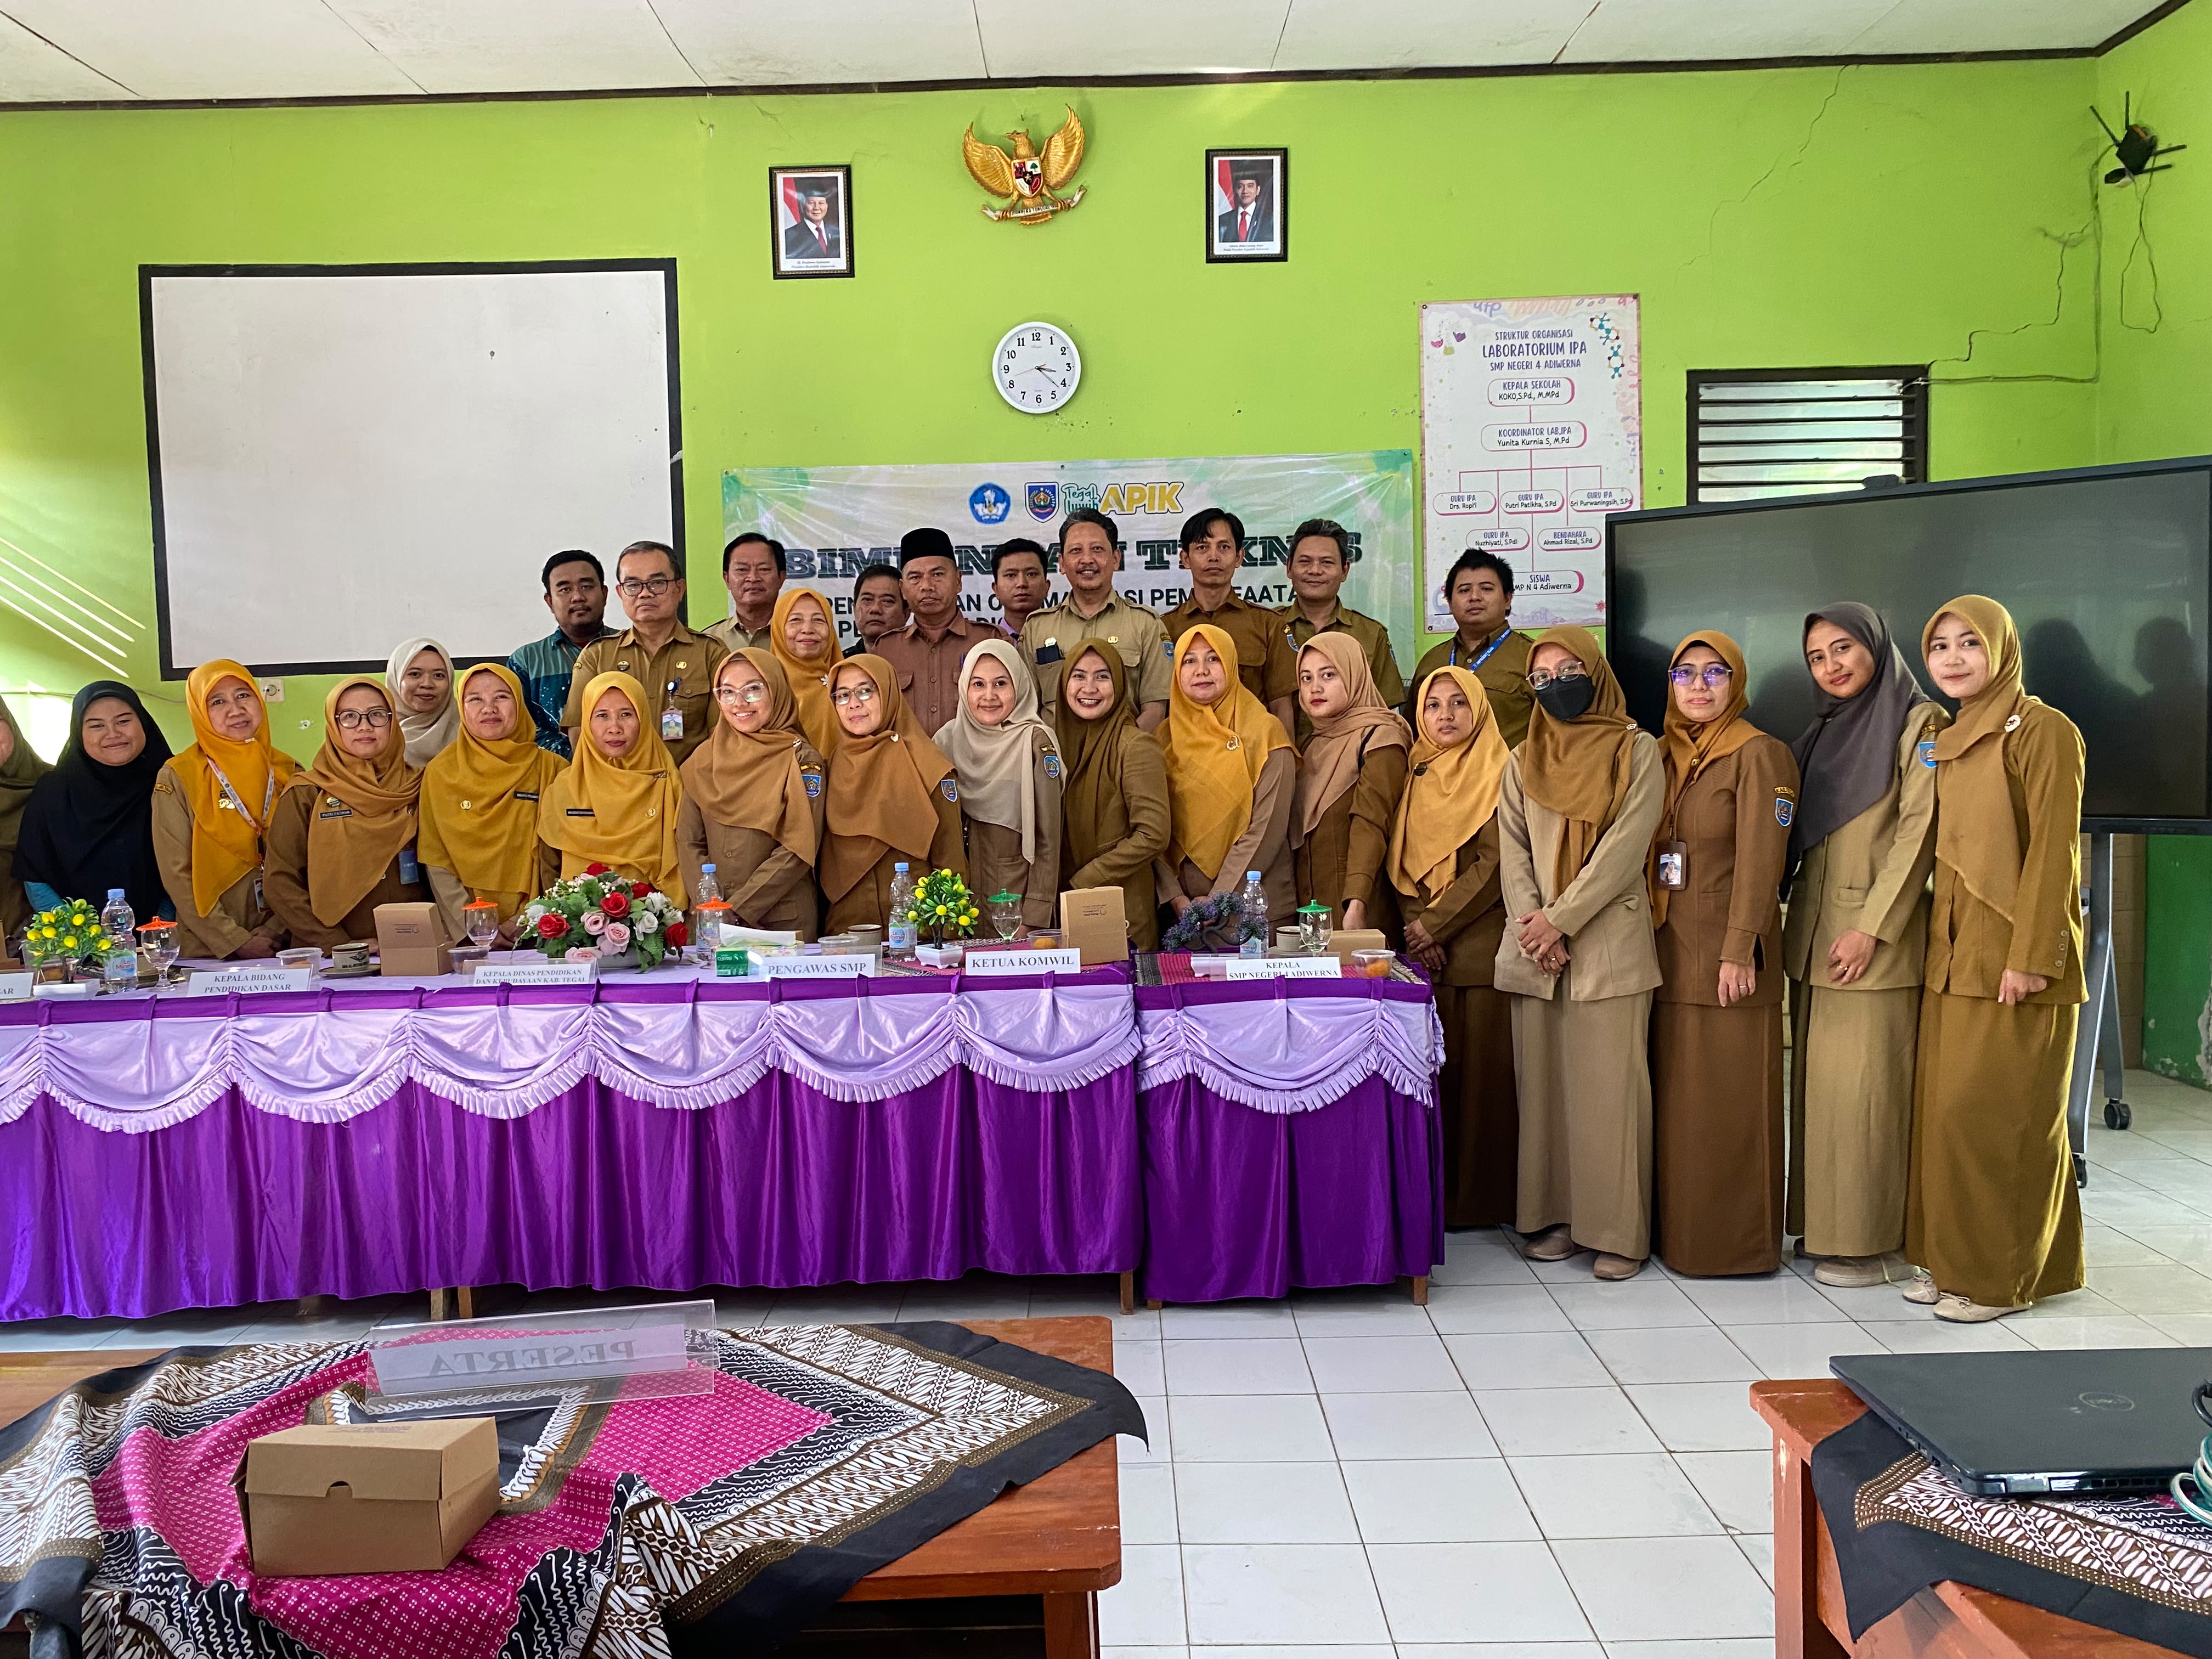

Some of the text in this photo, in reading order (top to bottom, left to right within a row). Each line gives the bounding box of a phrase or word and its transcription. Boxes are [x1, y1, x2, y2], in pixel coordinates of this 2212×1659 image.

[1031, 332, 1041, 341] 12
[1495, 330, 1529, 340] STRUKTUR
[1017, 337, 1025, 346] 11
[1049, 336, 1054, 345] 1
[1060, 347, 1066, 356] 2
[1482, 341, 1587, 358] LABORATORIUM IPA
[1007, 350, 1016, 359] 10
[1003, 365, 1009, 374] 9
[1065, 363, 1071, 371] 3
[1490, 359, 1581, 371] SMP NEGERI 4 ADIWERNA
[1008, 380, 1014, 389] 8
[1060, 378, 1066, 387] 4
[1503, 380, 1561, 390] KEPALA SEKOLAH
[1020, 391, 1026, 400] 7
[1036, 394, 1042, 403] 6
[1051, 391, 1057, 399] 5
[1498, 427, 1544, 437] KOORDINATOR
[1064, 486, 1097, 501] Tegal
[1099, 484, 1181, 513] APIK
[1554, 531, 1587, 539] BENDAHARA
[971, 955, 1074, 969] KETUA KOMWIL
[769, 963, 866, 974] PENGAWAS SMP
[204, 985, 261, 994] PENDIDIKAN
